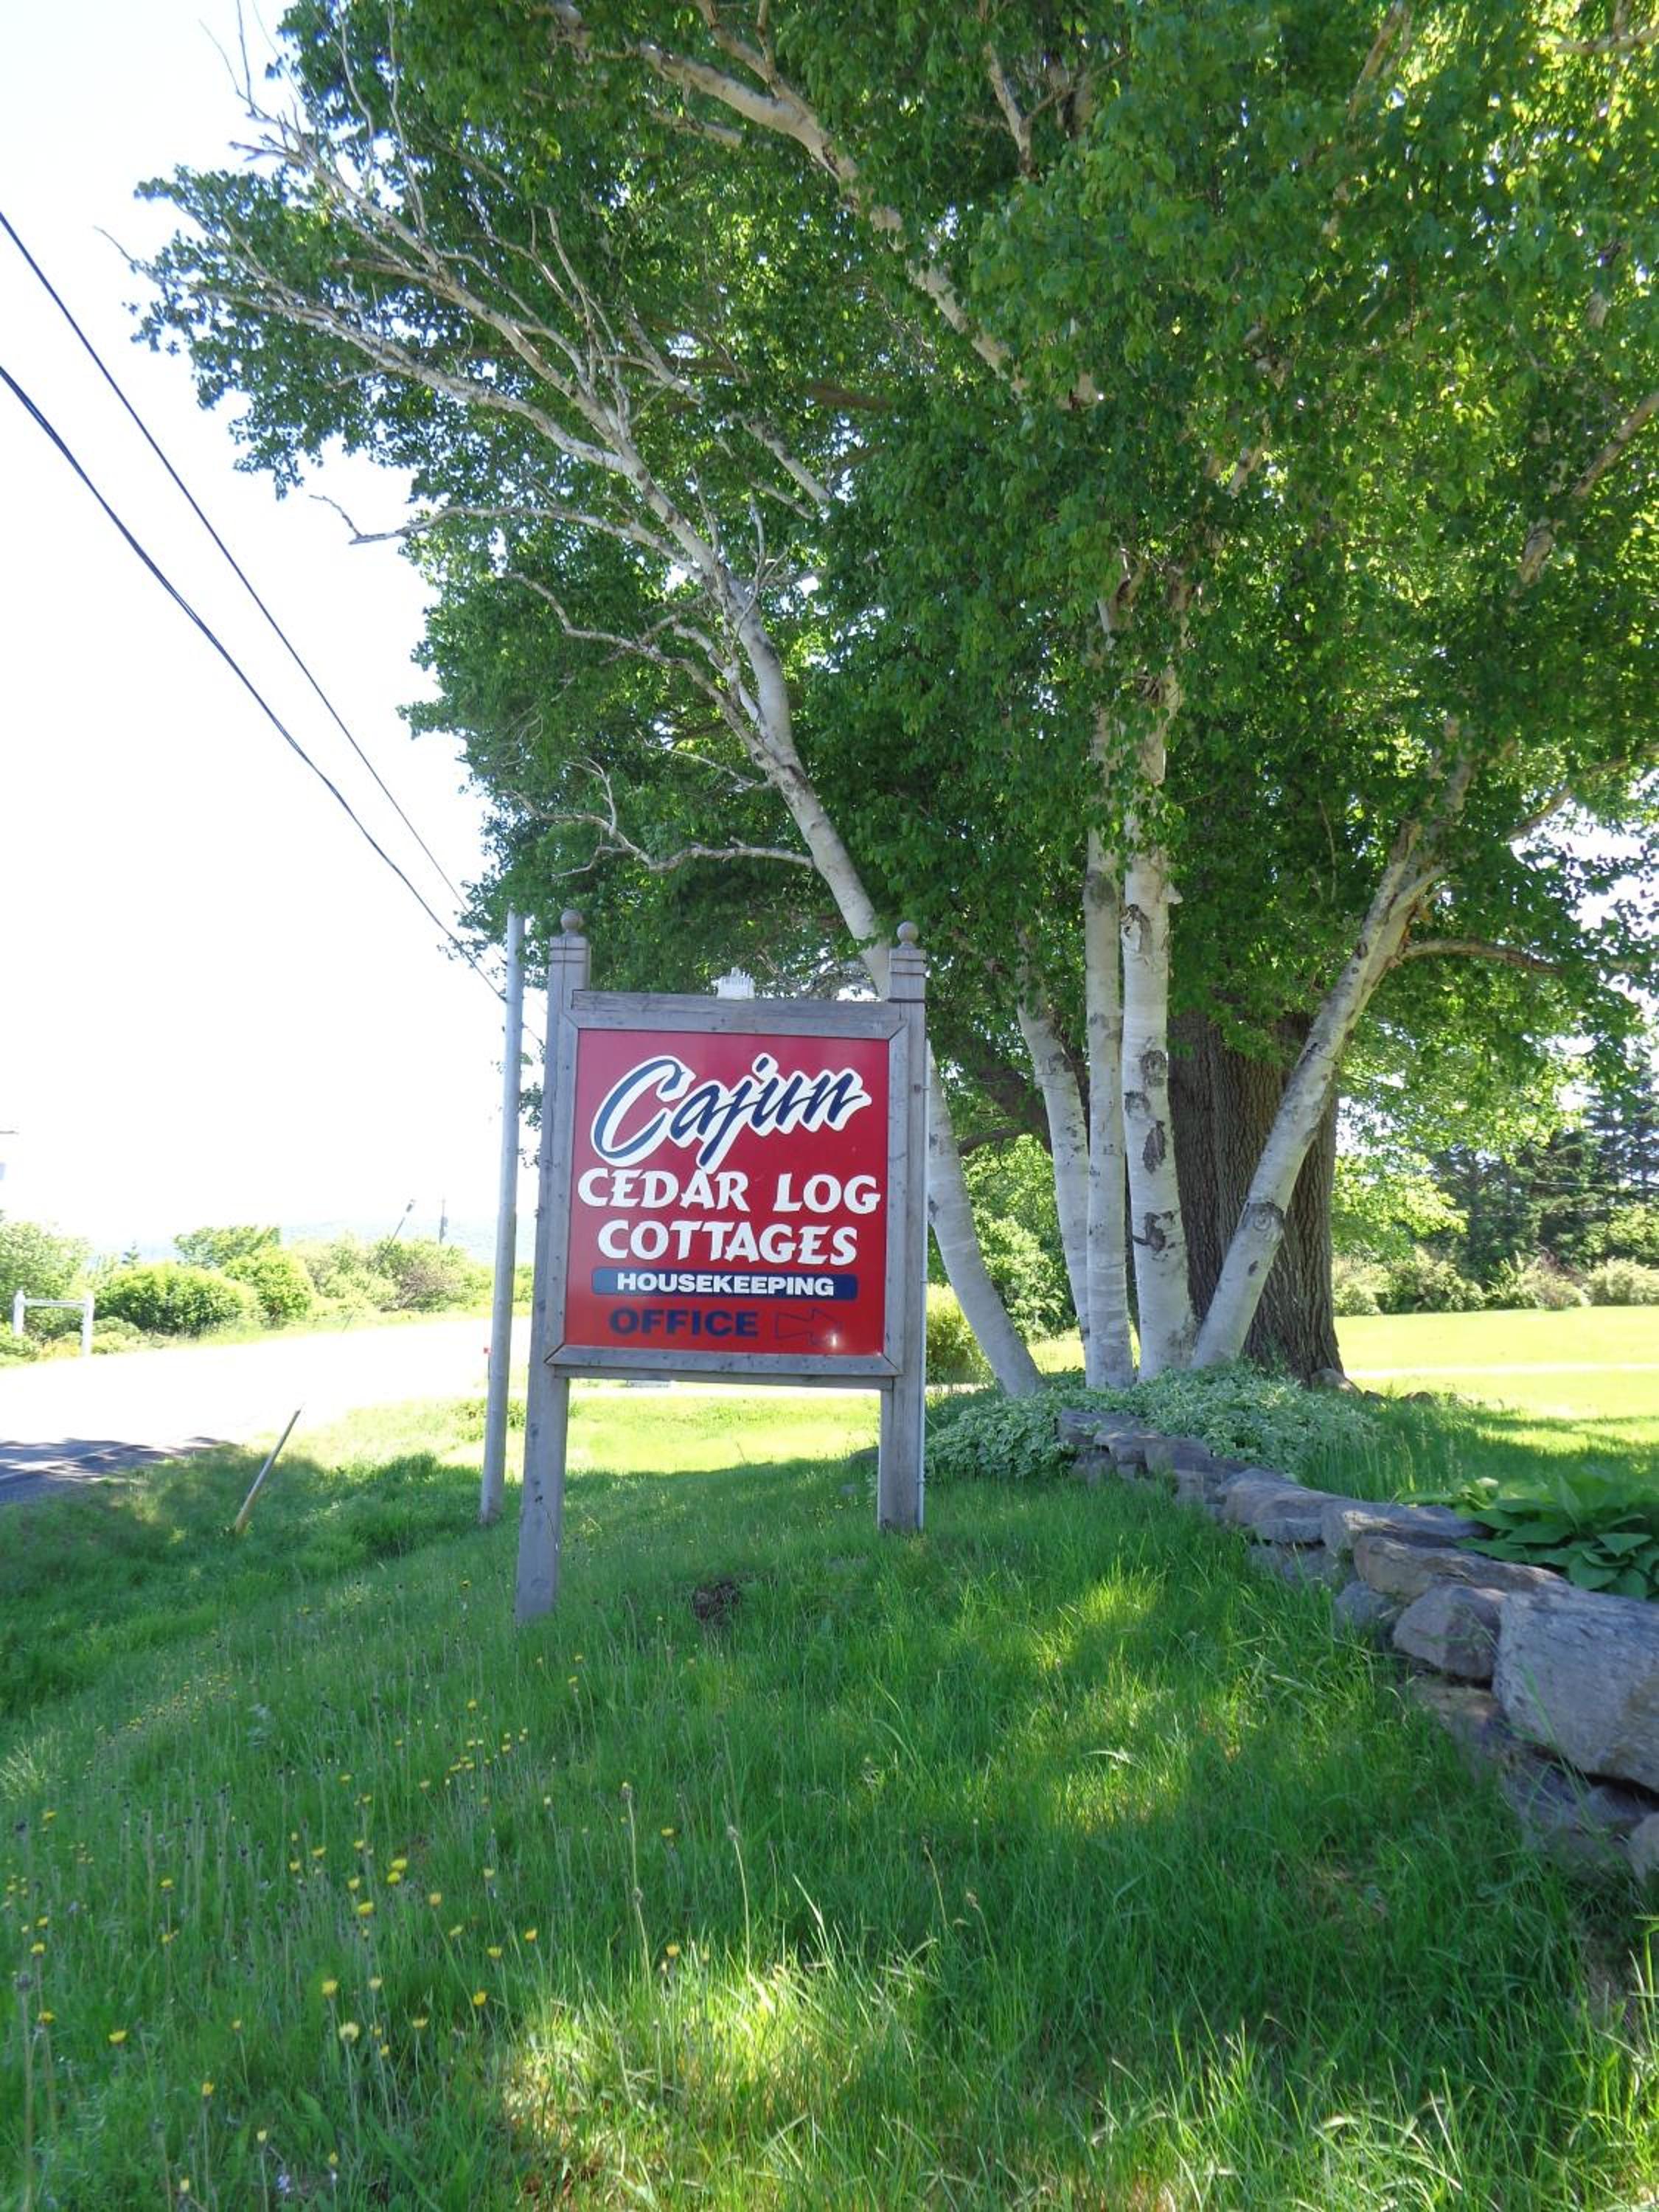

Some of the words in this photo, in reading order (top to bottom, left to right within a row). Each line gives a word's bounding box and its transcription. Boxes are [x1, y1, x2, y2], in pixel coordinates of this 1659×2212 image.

[591, 1053, 872, 1172] Cajun
[577, 1167, 751, 1212] CEDAR
[773, 1172, 881, 1214] LOG
[597, 1219, 858, 1267] COTTAGES
[617, 1272, 835, 1295] HOUSEKEEPING
[608, 1307, 759, 1338] OFFICE
